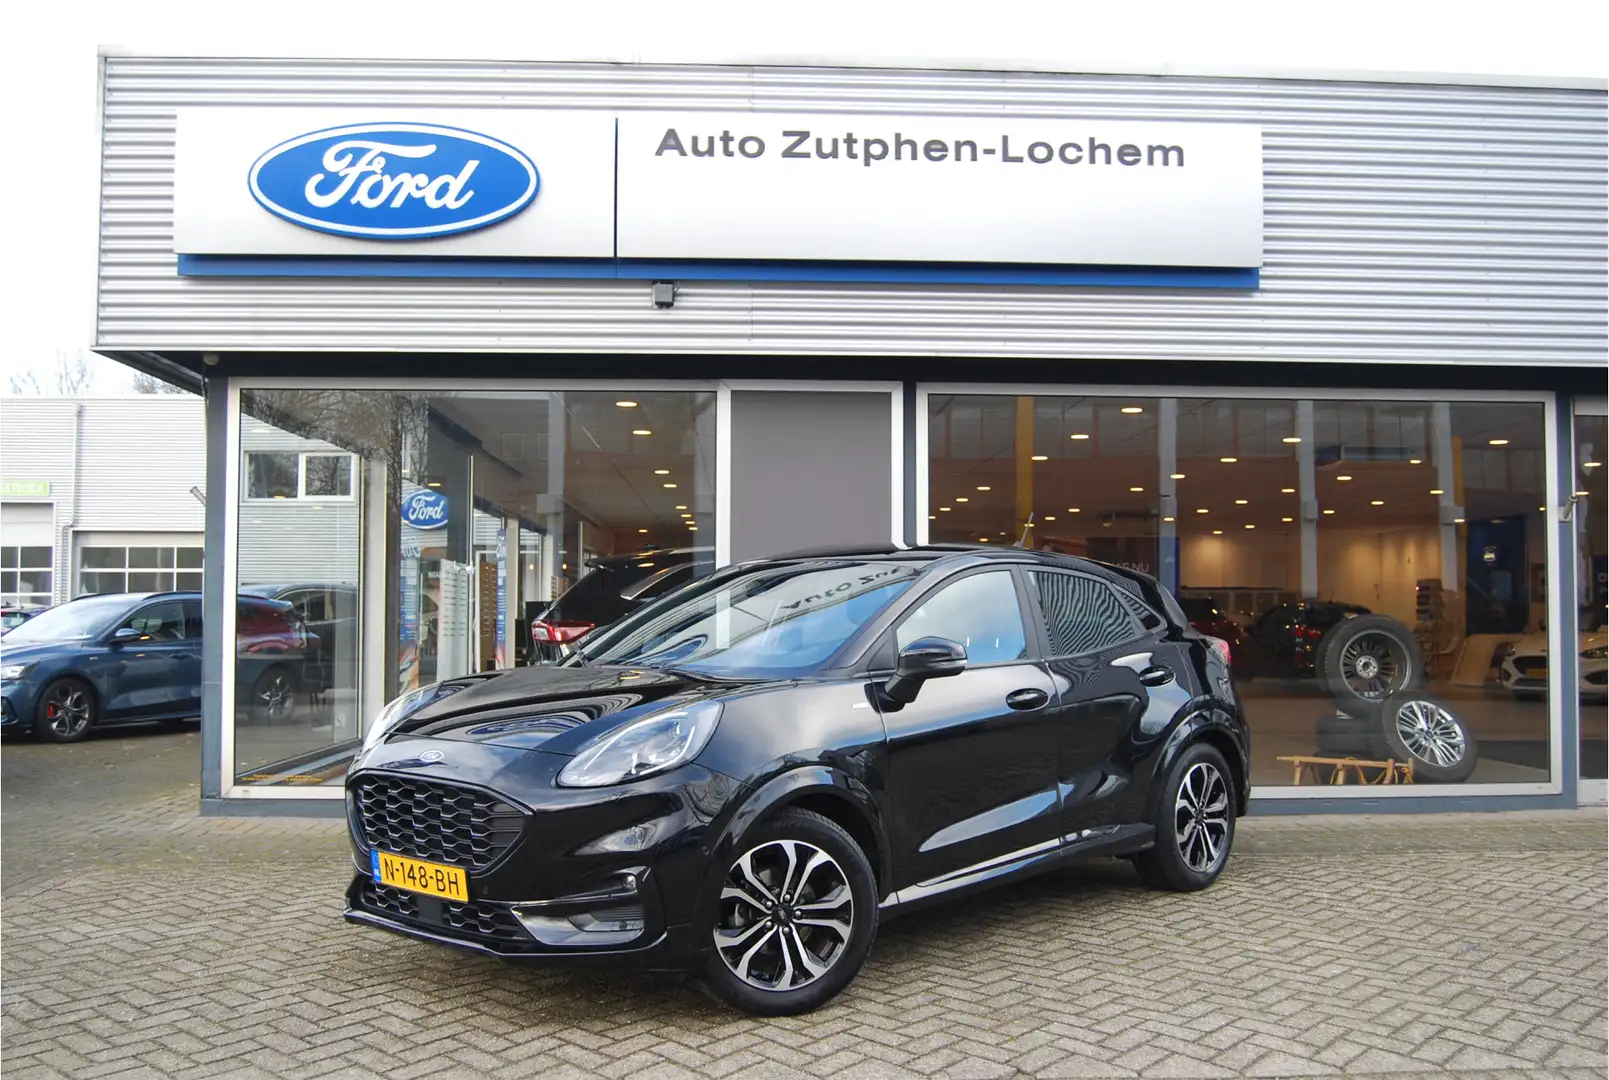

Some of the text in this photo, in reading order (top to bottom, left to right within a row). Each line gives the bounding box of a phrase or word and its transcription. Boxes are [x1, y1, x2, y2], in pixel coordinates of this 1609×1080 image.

[655, 128, 1185, 167] Auto Zutphen-Lochem
[304, 140, 480, 210] Ford
[408, 495, 445, 521] Ford
[383, 857, 460, 896] N-148-BH
